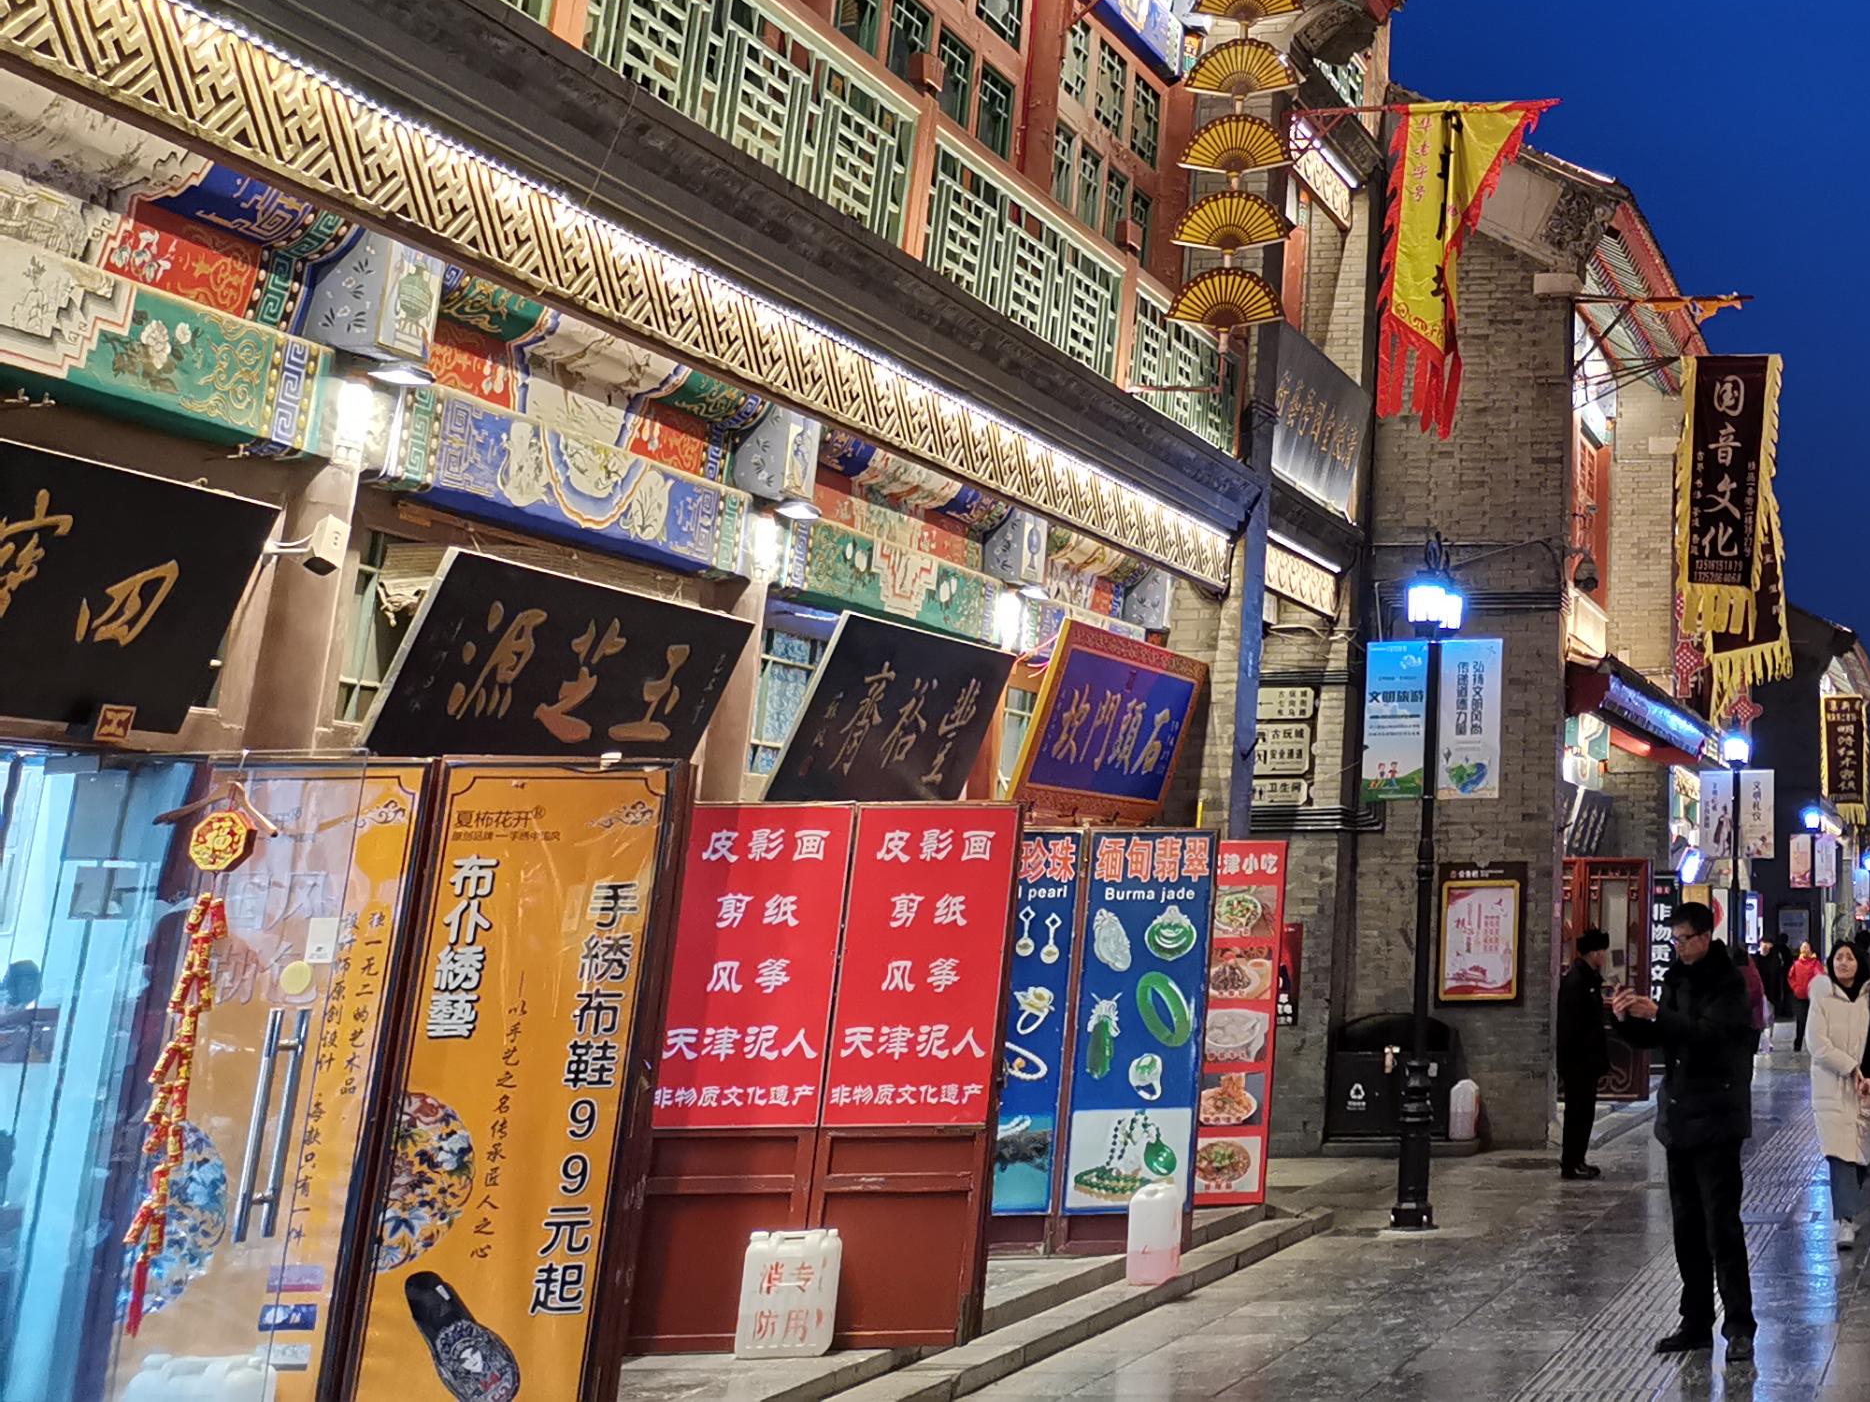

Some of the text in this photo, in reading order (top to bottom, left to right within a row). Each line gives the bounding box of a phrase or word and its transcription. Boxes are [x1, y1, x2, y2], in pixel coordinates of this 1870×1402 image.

[1702, 375, 1745, 557] 国音文化
[1269, 783, 1301, 793] 卫生间
[702, 829, 830, 863] 皮影画
[876, 829, 996, 862] 皮影画
[1096, 837, 1209, 883] 缅甸翡翠
[1217, 853, 1279, 875] 津小吃
[716, 893, 799, 927] 剪纸
[891, 893, 967, 927] 剪纸
[1028, 885, 1067, 903] pearl
[1104, 885, 1195, 904] Burma jade
[706, 959, 791, 993] 风筝
[881, 959, 960, 993] 风筝
[663, 1025, 818, 1061] 天津泥人
[840, 1025, 985, 1060] 天津泥人
[654, 1084, 815, 1108] 非物质文化遗产
[830, 1084, 983, 1107] 非物质文化遗产
